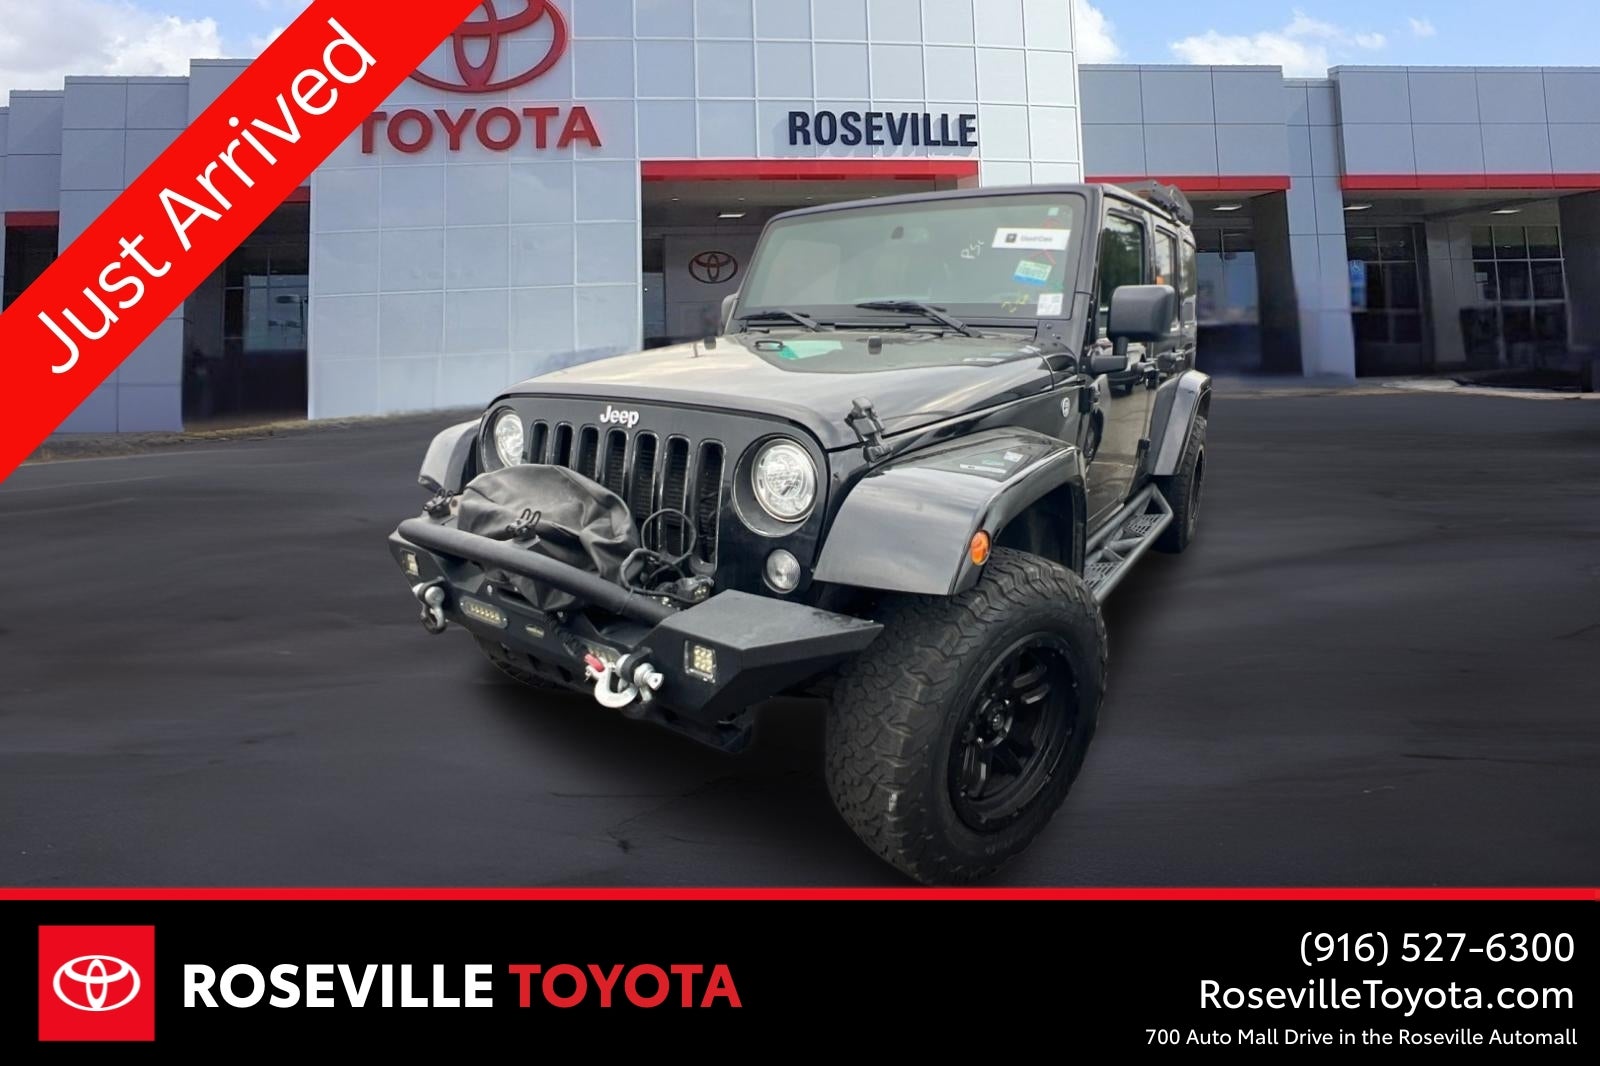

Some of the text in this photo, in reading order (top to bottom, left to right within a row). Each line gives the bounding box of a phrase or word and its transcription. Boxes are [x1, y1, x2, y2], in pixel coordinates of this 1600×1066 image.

[360, 106, 603, 154] TOYOTA
[788, 111, 978, 148] ROSEVILLE
[599, 404, 640, 429] Jeep
